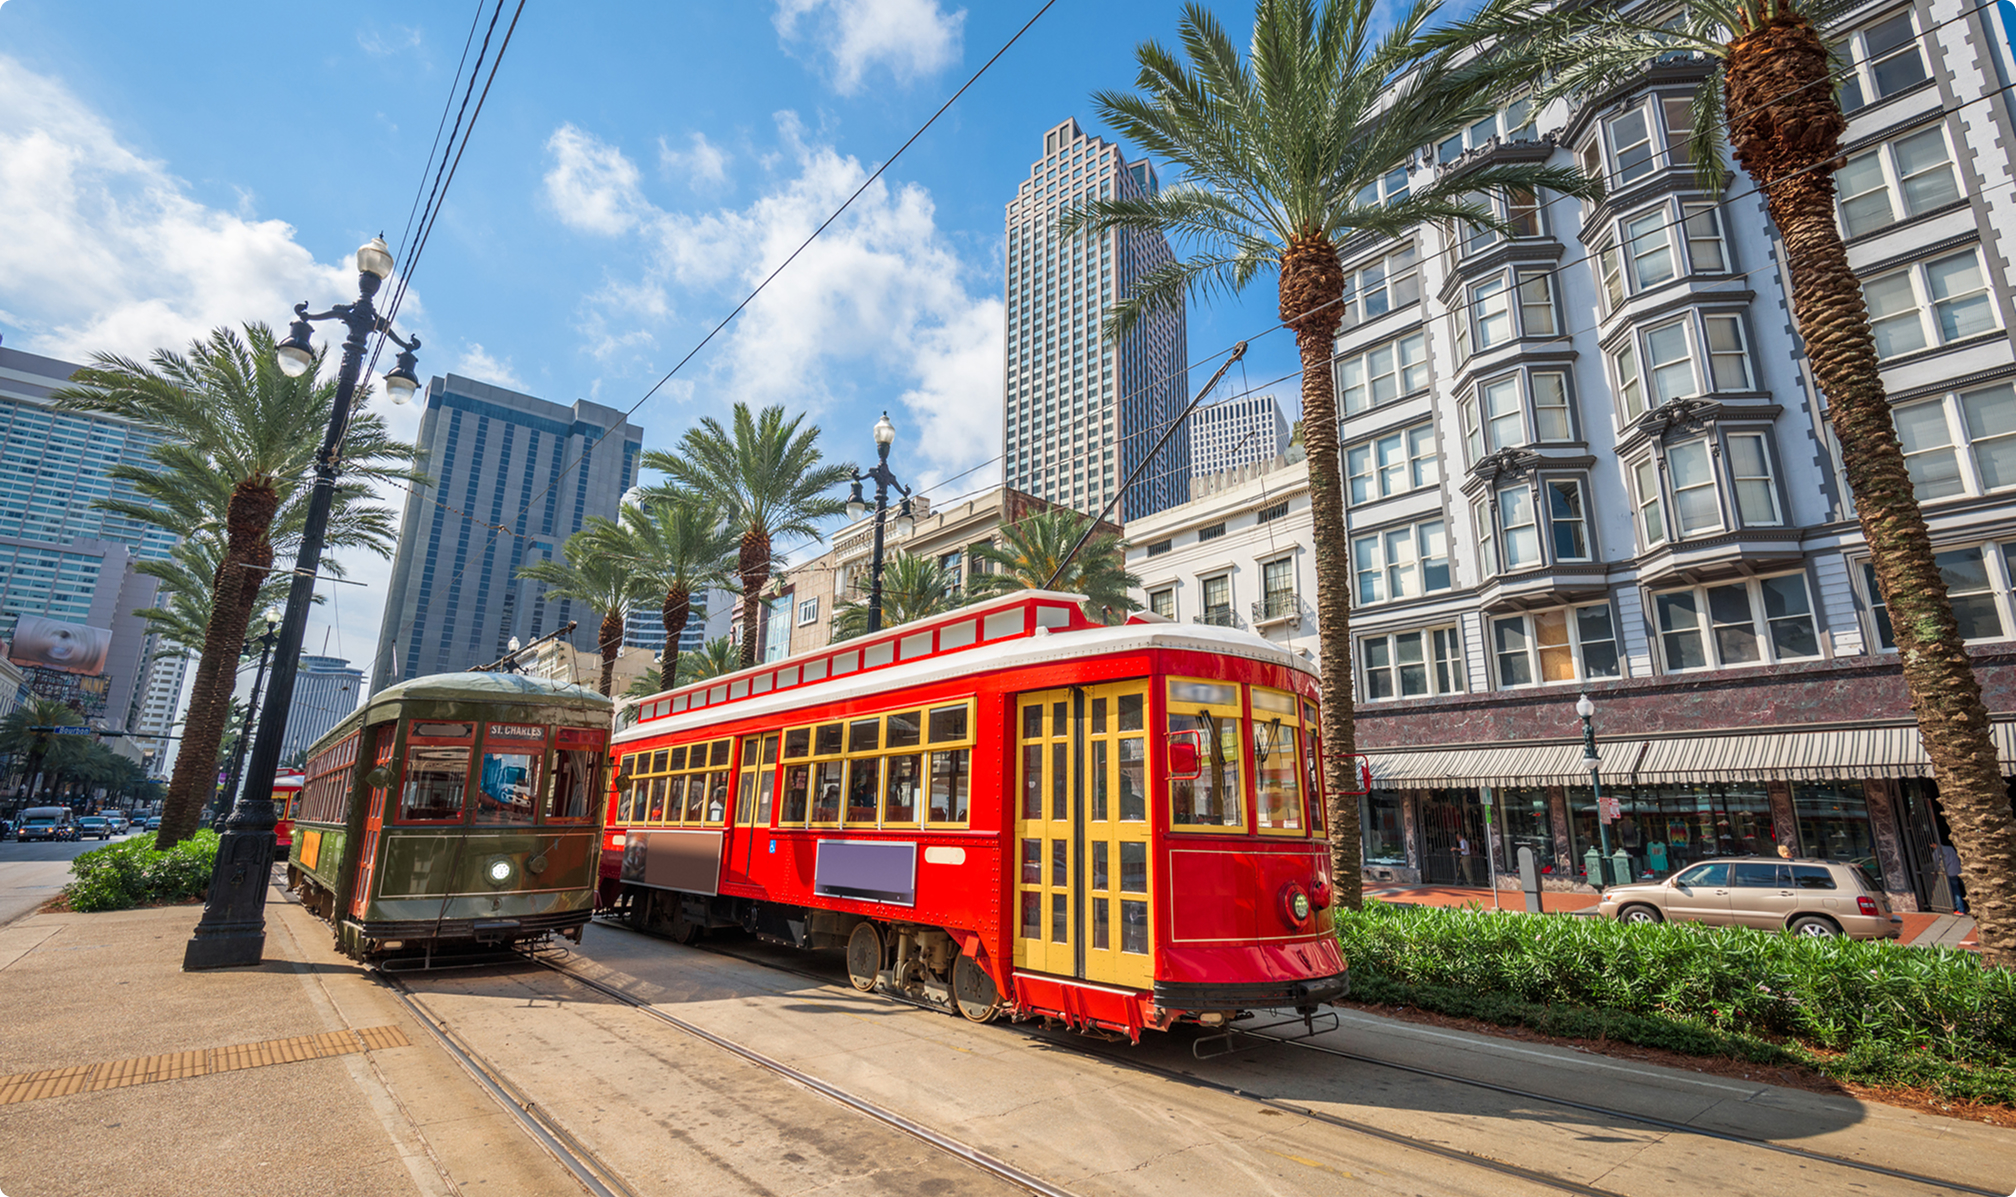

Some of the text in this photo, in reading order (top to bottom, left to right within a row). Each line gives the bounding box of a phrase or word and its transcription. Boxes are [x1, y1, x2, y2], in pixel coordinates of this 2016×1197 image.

[60, 726, 89, 735] Bourbon
[491, 725, 542, 737] ST. CHARLES
